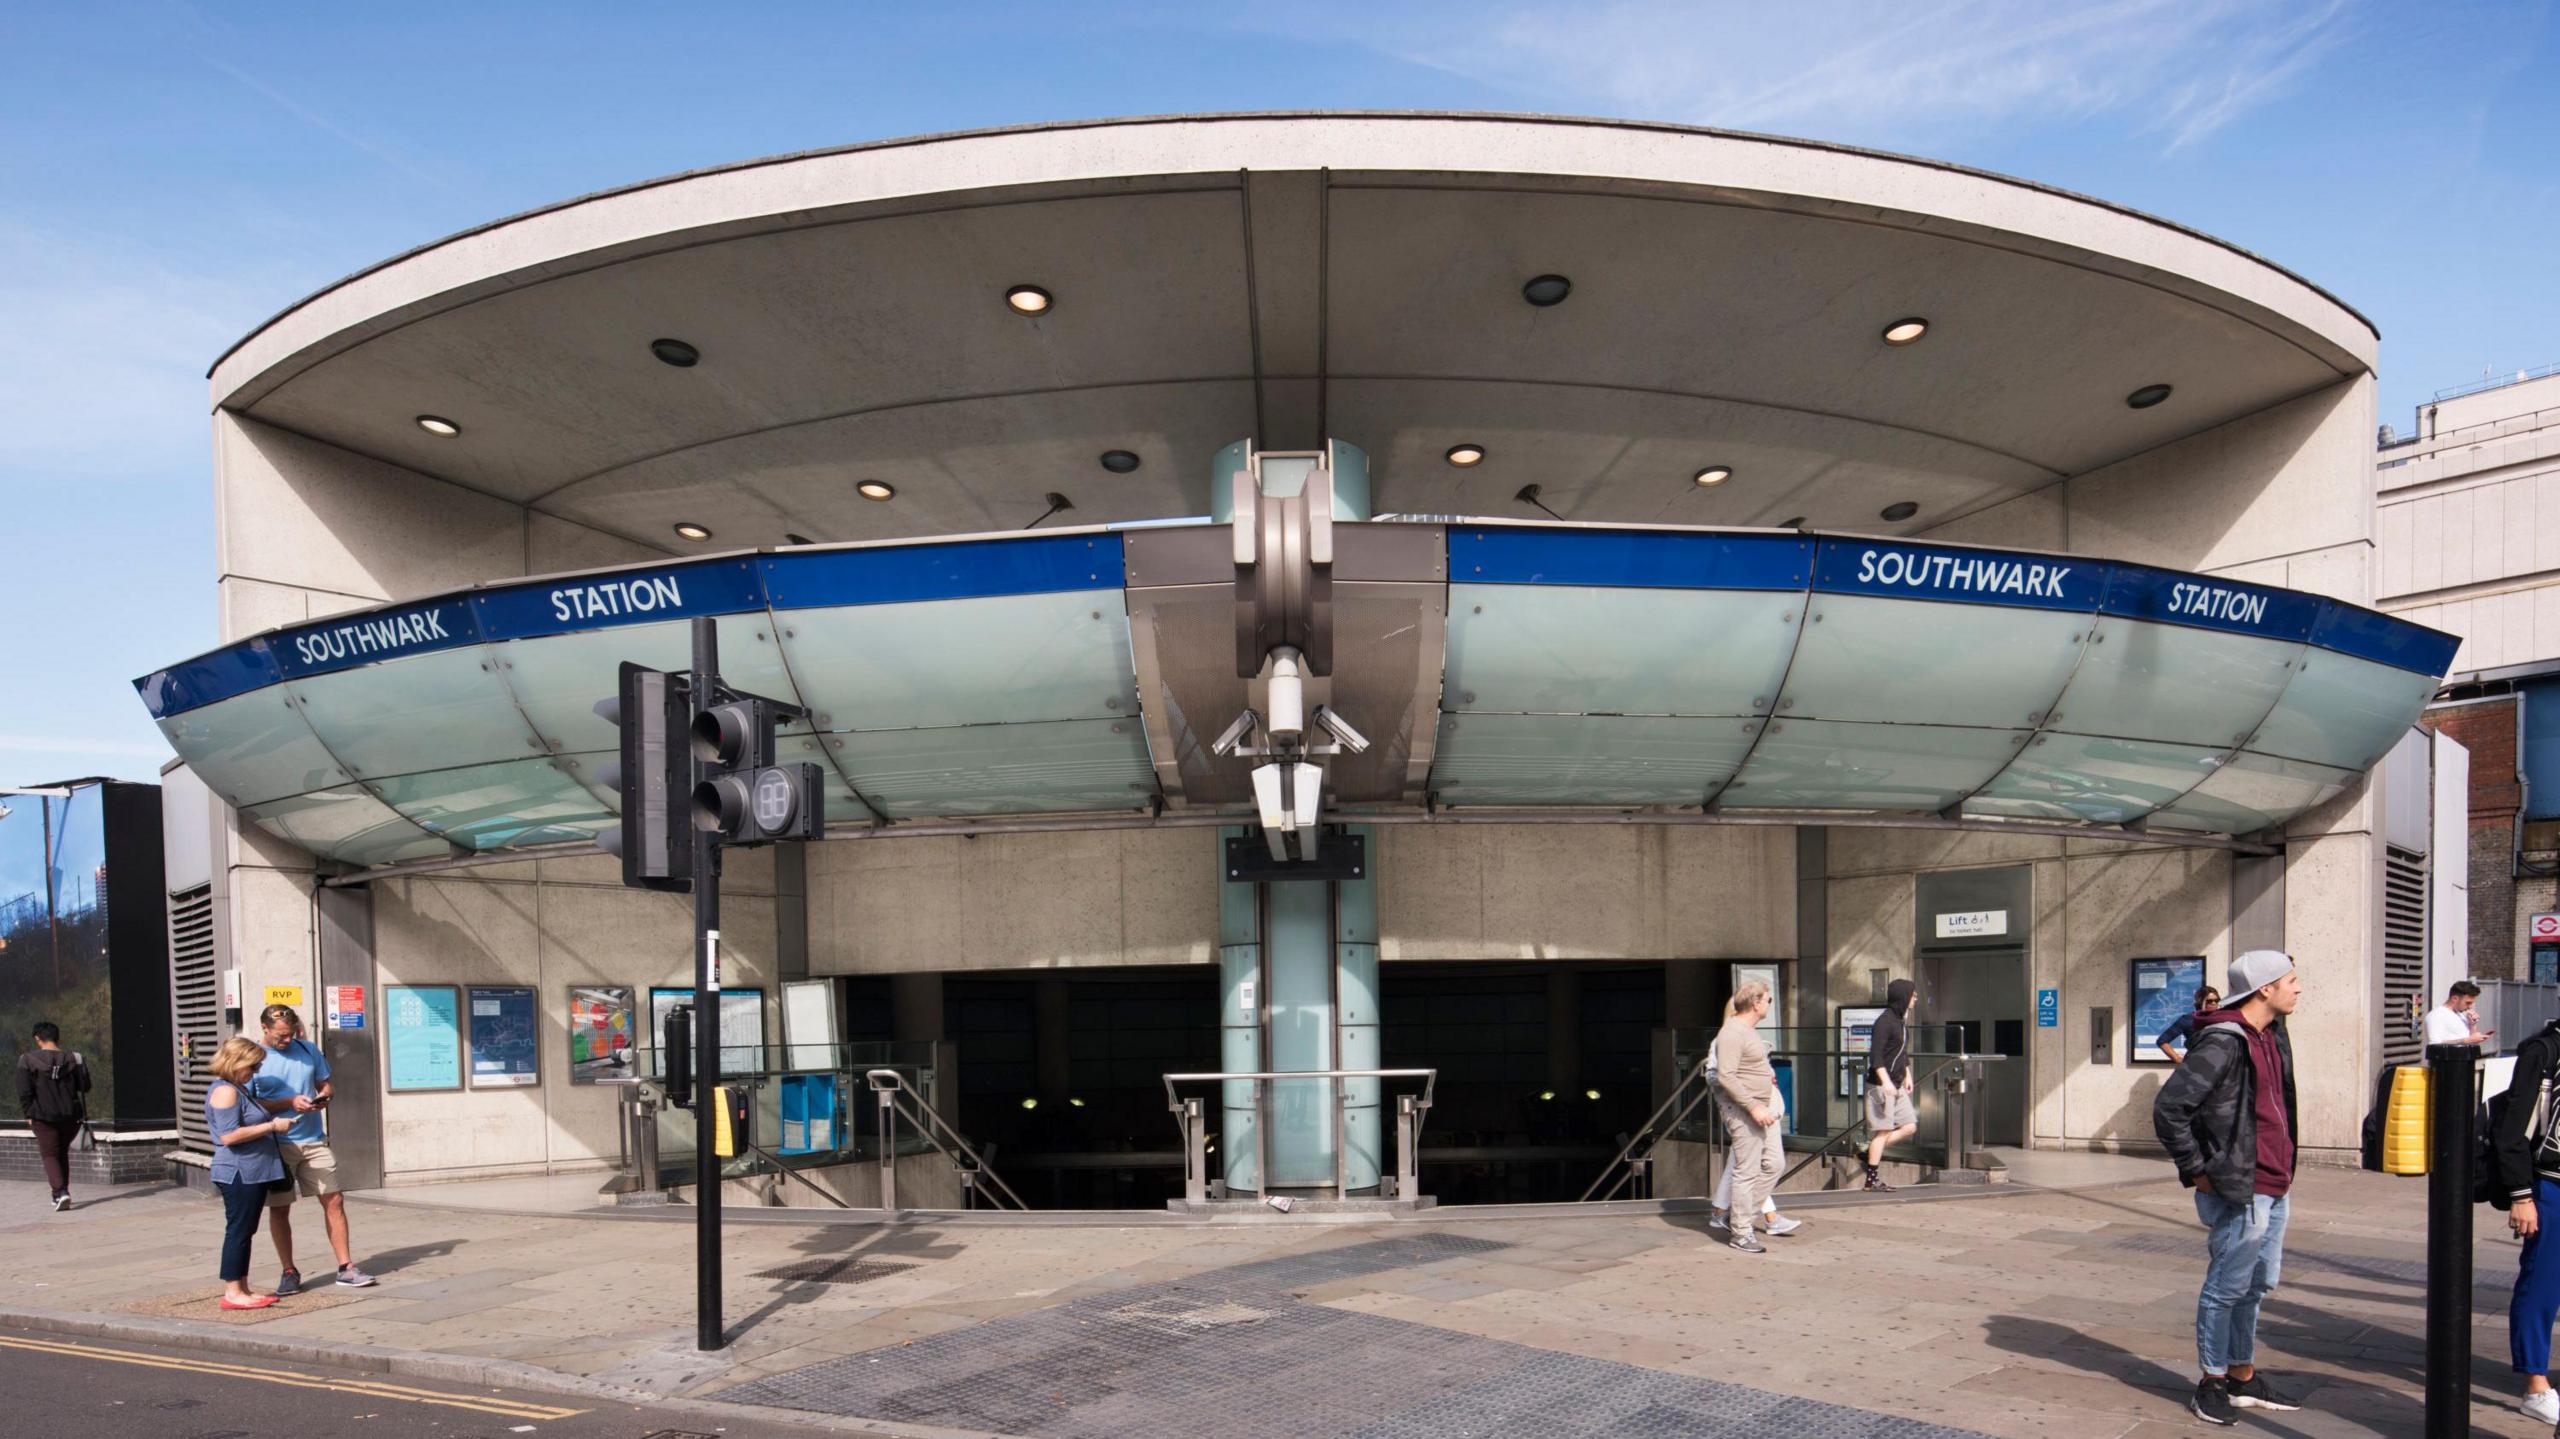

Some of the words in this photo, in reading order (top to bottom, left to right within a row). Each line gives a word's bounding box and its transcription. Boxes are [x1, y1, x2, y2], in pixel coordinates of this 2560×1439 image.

[1857, 550, 2071, 599] SOUTHWARK
[2168, 582, 2268, 625] STATION
[296, 609, 449, 665] SOUTHWARK
[551, 576, 682, 622] STATION
[1949, 916, 1967, 925] Lift
[272, 990, 293, 999] RVP
